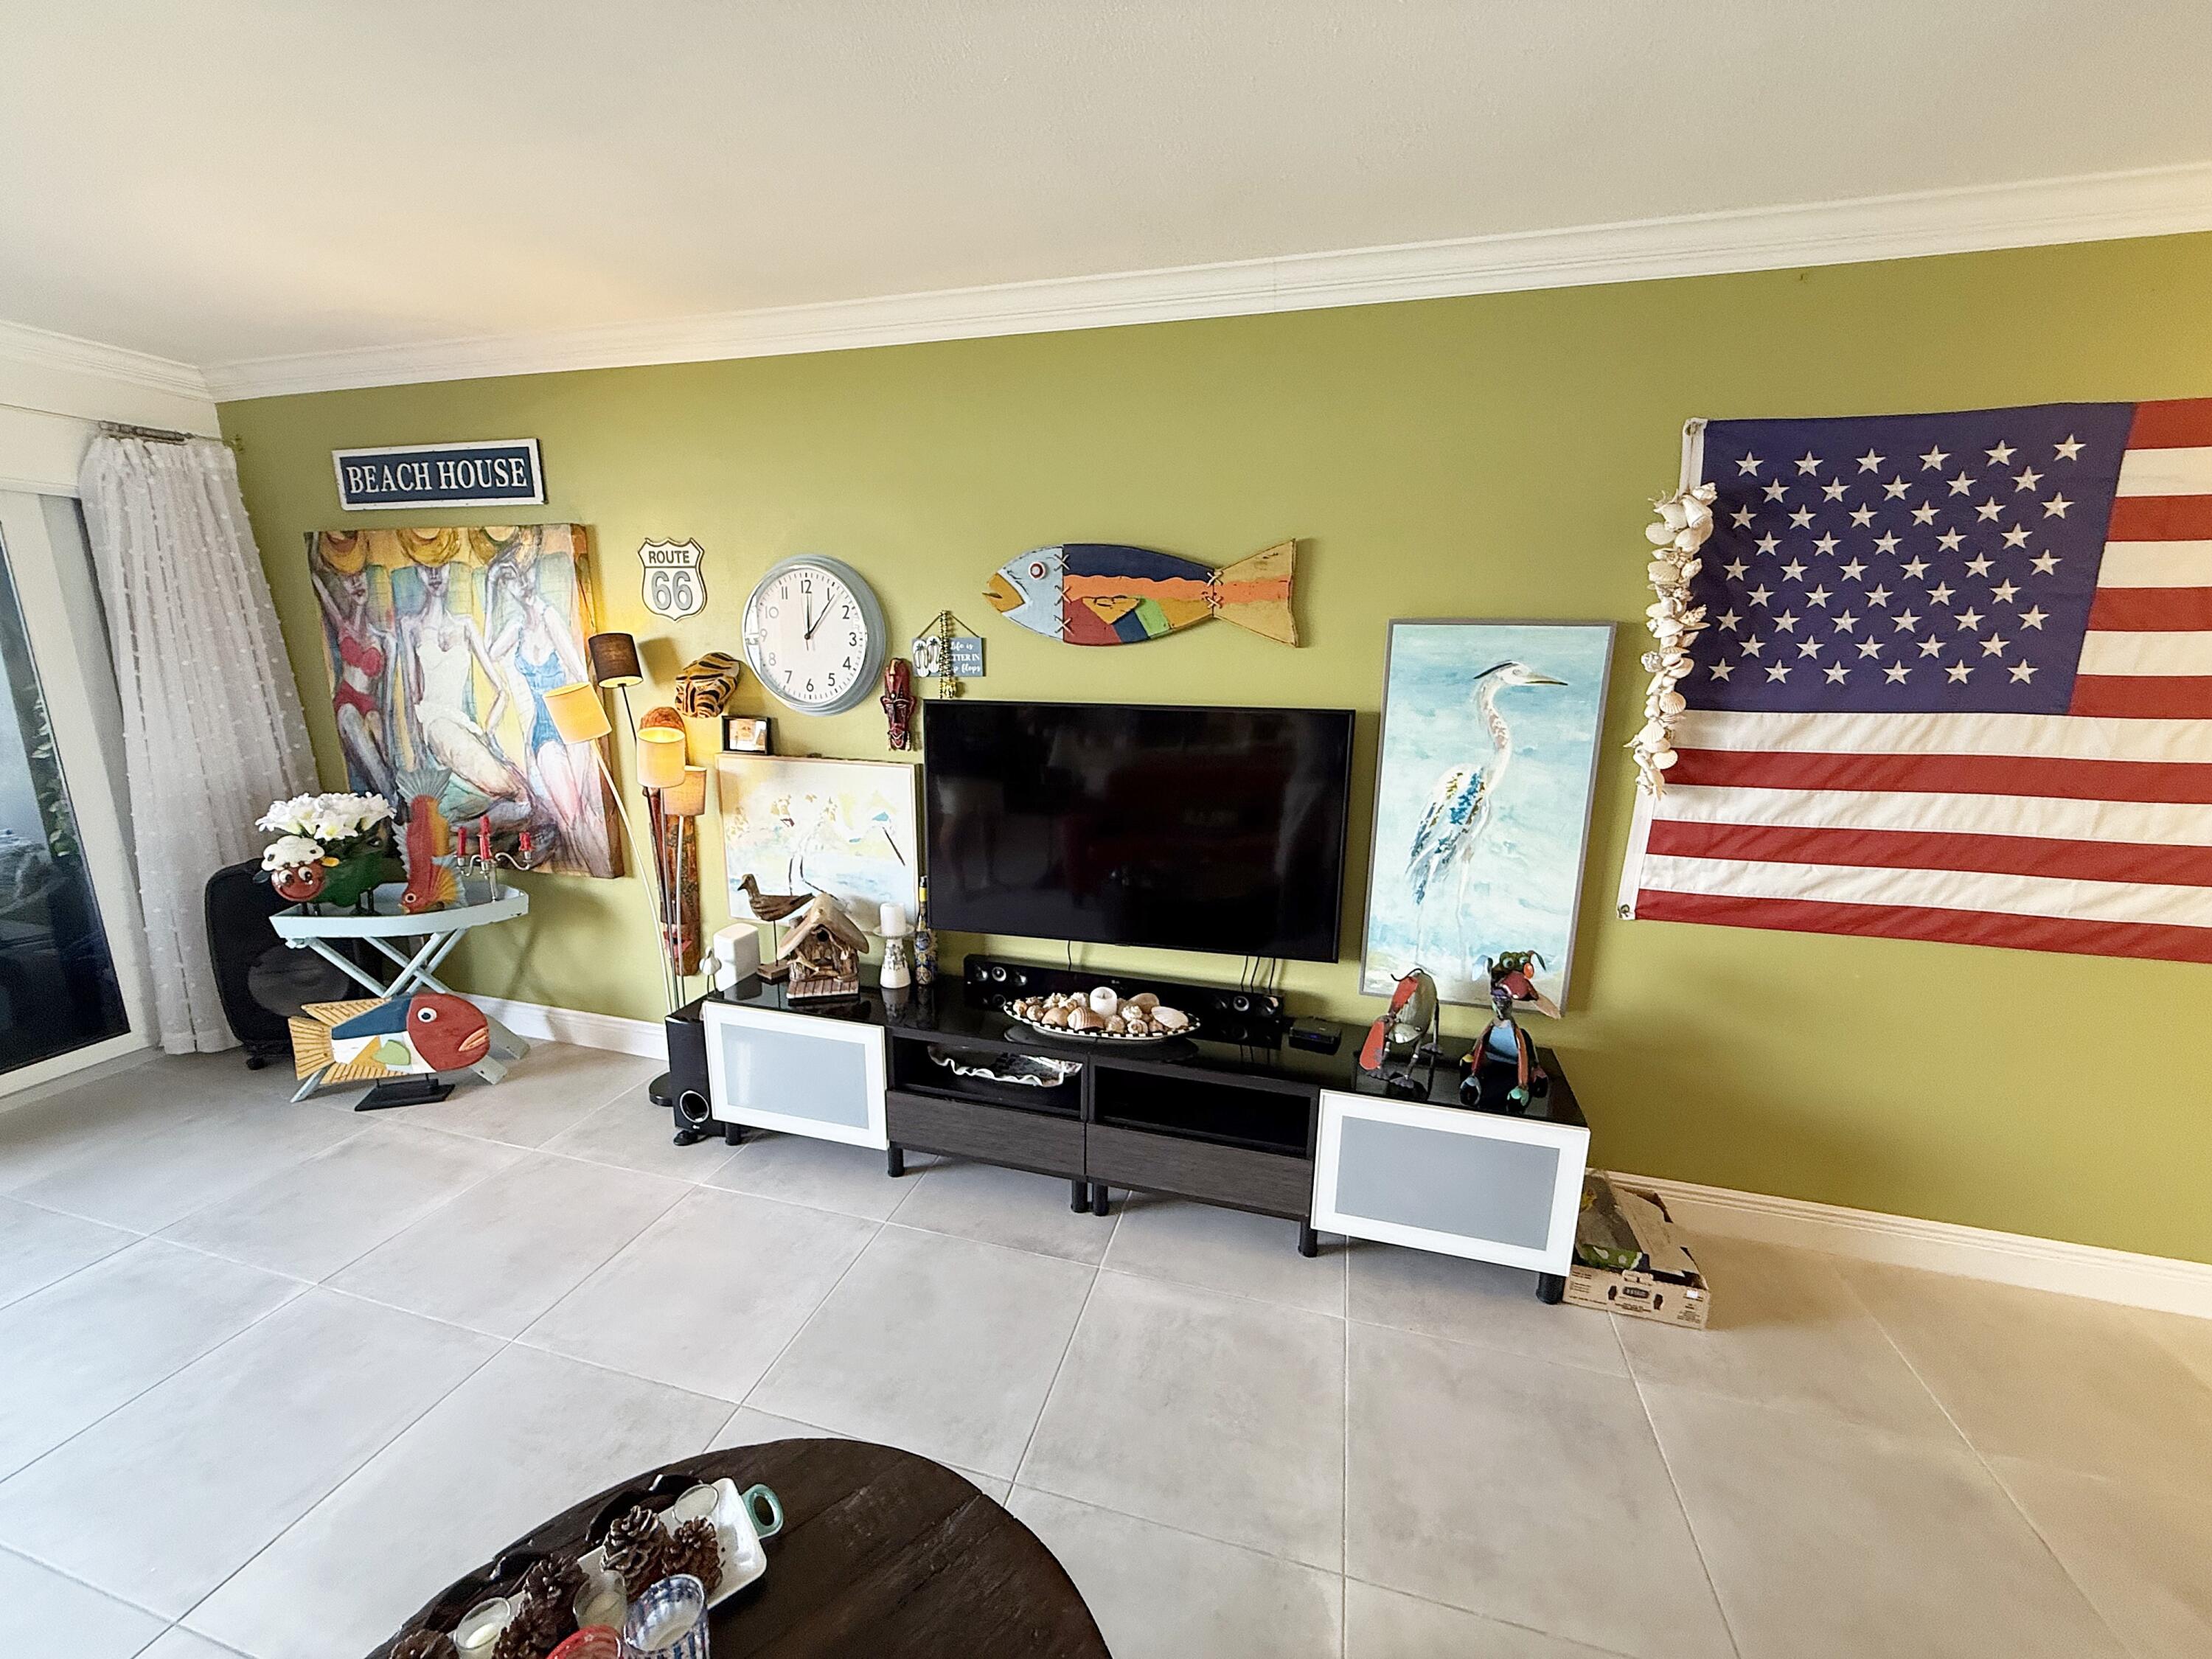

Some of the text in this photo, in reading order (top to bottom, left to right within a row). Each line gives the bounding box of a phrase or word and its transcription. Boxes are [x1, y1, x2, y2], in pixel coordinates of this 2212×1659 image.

[346, 458, 528, 493] BEACH HOUSE
[648, 550, 690, 563] ROUTE
[651, 570, 693, 611] 66
[782, 586, 788, 599] 11
[801, 580, 812, 594] 12
[827, 588, 830, 600] 1
[765, 606, 779, 619] 10
[842, 605, 849, 619] 2
[760, 628, 768, 642] 9
[849, 632, 857, 646] 3
[966, 642, 974, 650] is
[769, 653, 776, 666] 8
[843, 656, 852, 670] 4
[951, 653, 981, 661] TTER IN
[961, 663, 981, 674] flops
[785, 670, 793, 684] 7
[828, 673, 835, 686] 5
[806, 678, 814, 692] 6
